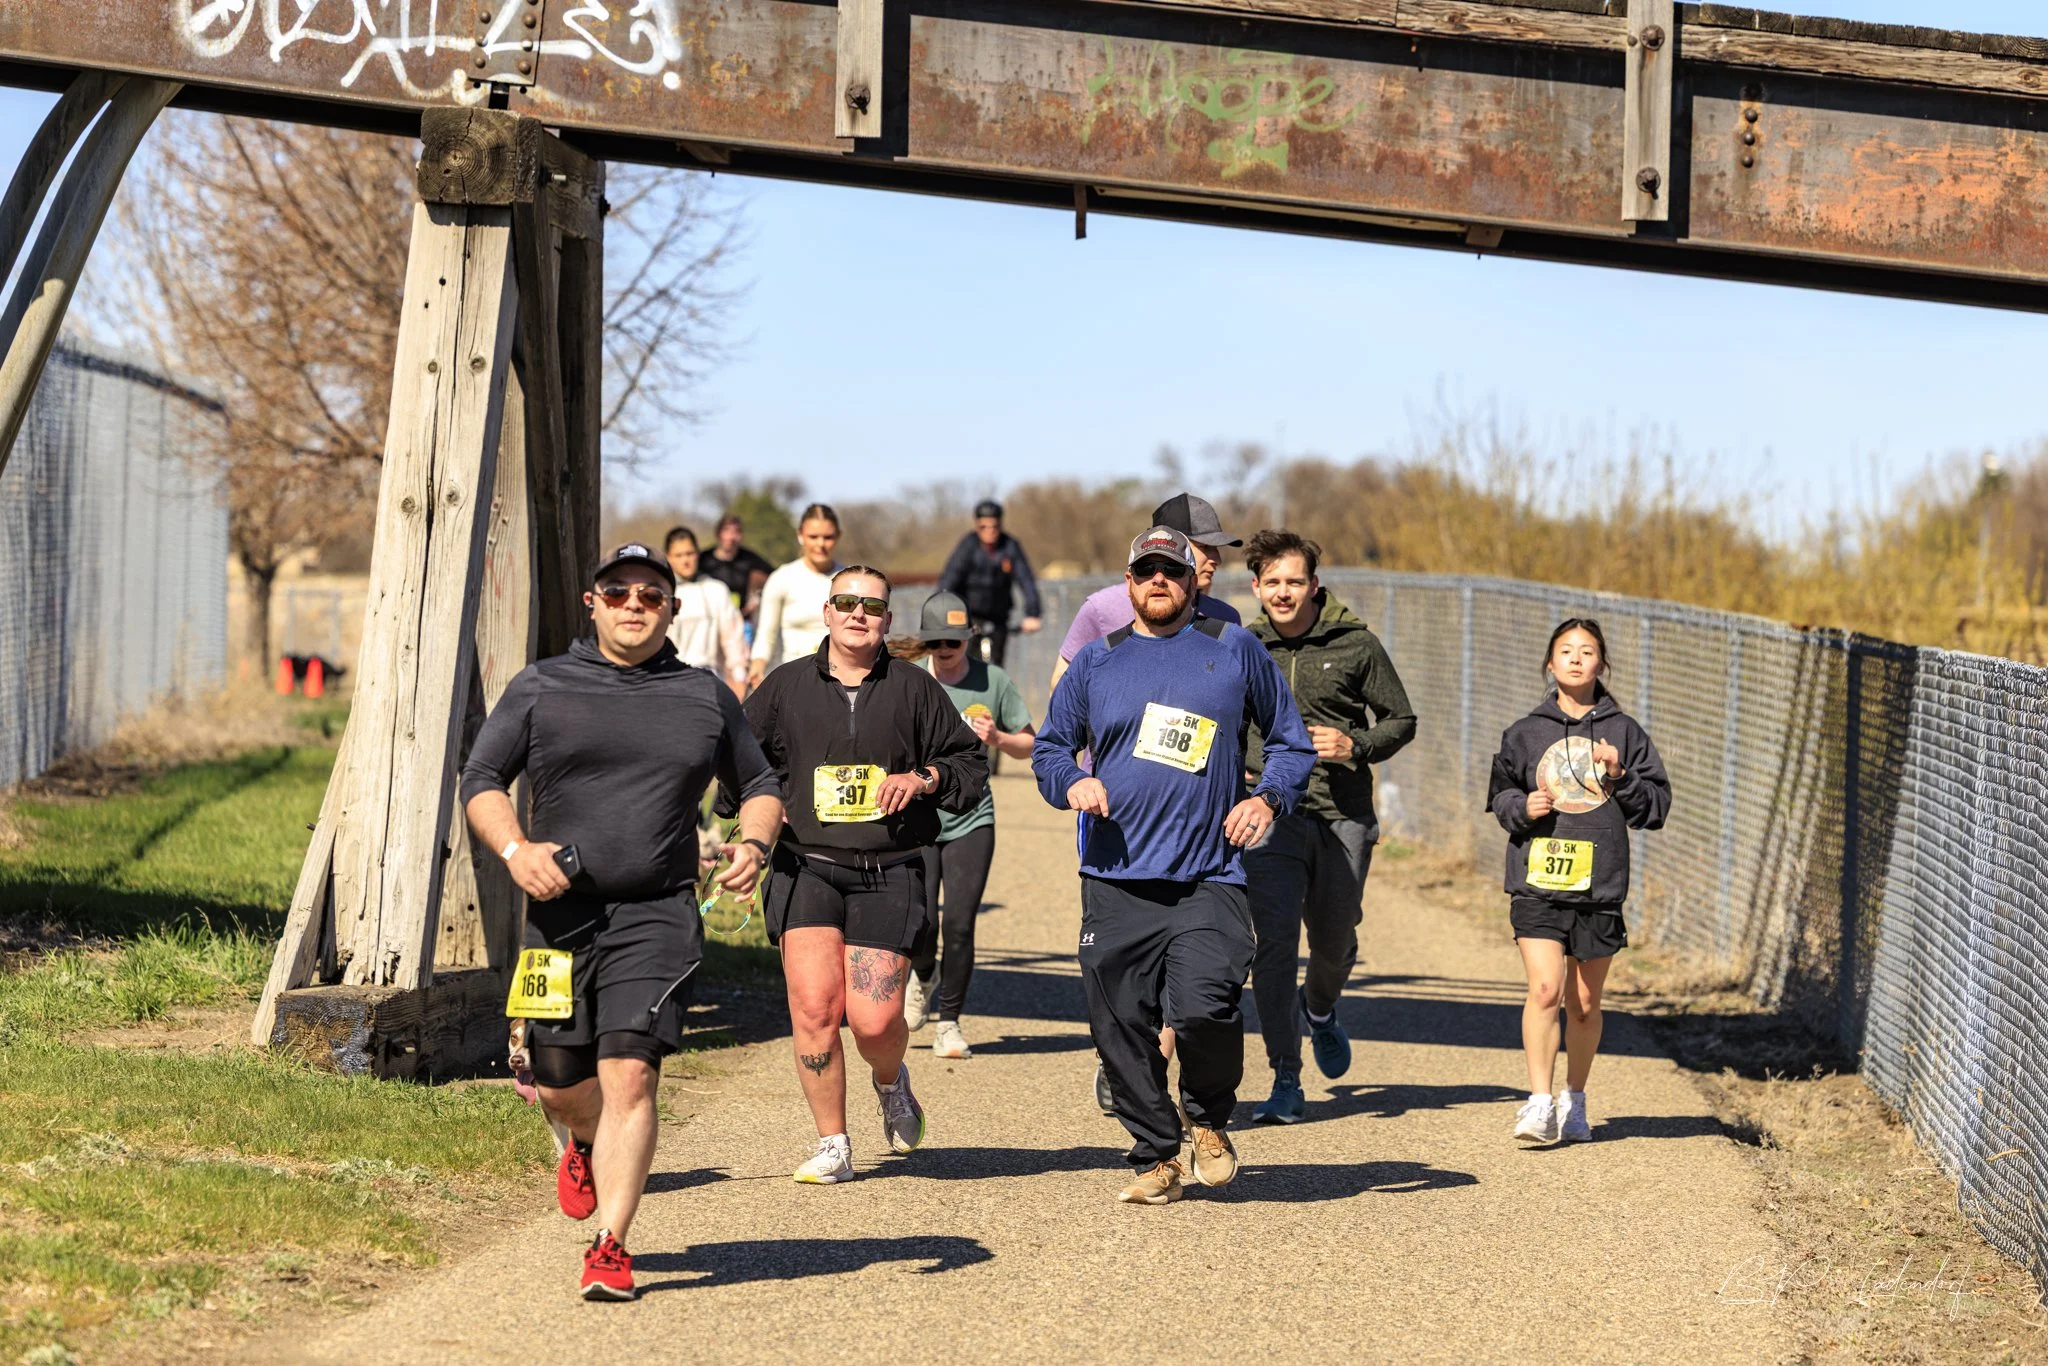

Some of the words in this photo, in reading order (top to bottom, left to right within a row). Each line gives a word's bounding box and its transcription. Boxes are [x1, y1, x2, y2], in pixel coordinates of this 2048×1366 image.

[1183, 715, 1200, 730] 5K
[1158, 727, 1192, 753] 198
[855, 768, 870, 780] 5K
[836, 784, 867, 806] 197
[1563, 843, 1577, 854] 5K
[1545, 856, 1574, 876] 377
[537, 953, 551, 968] 5K
[521, 974, 548, 998] 168
